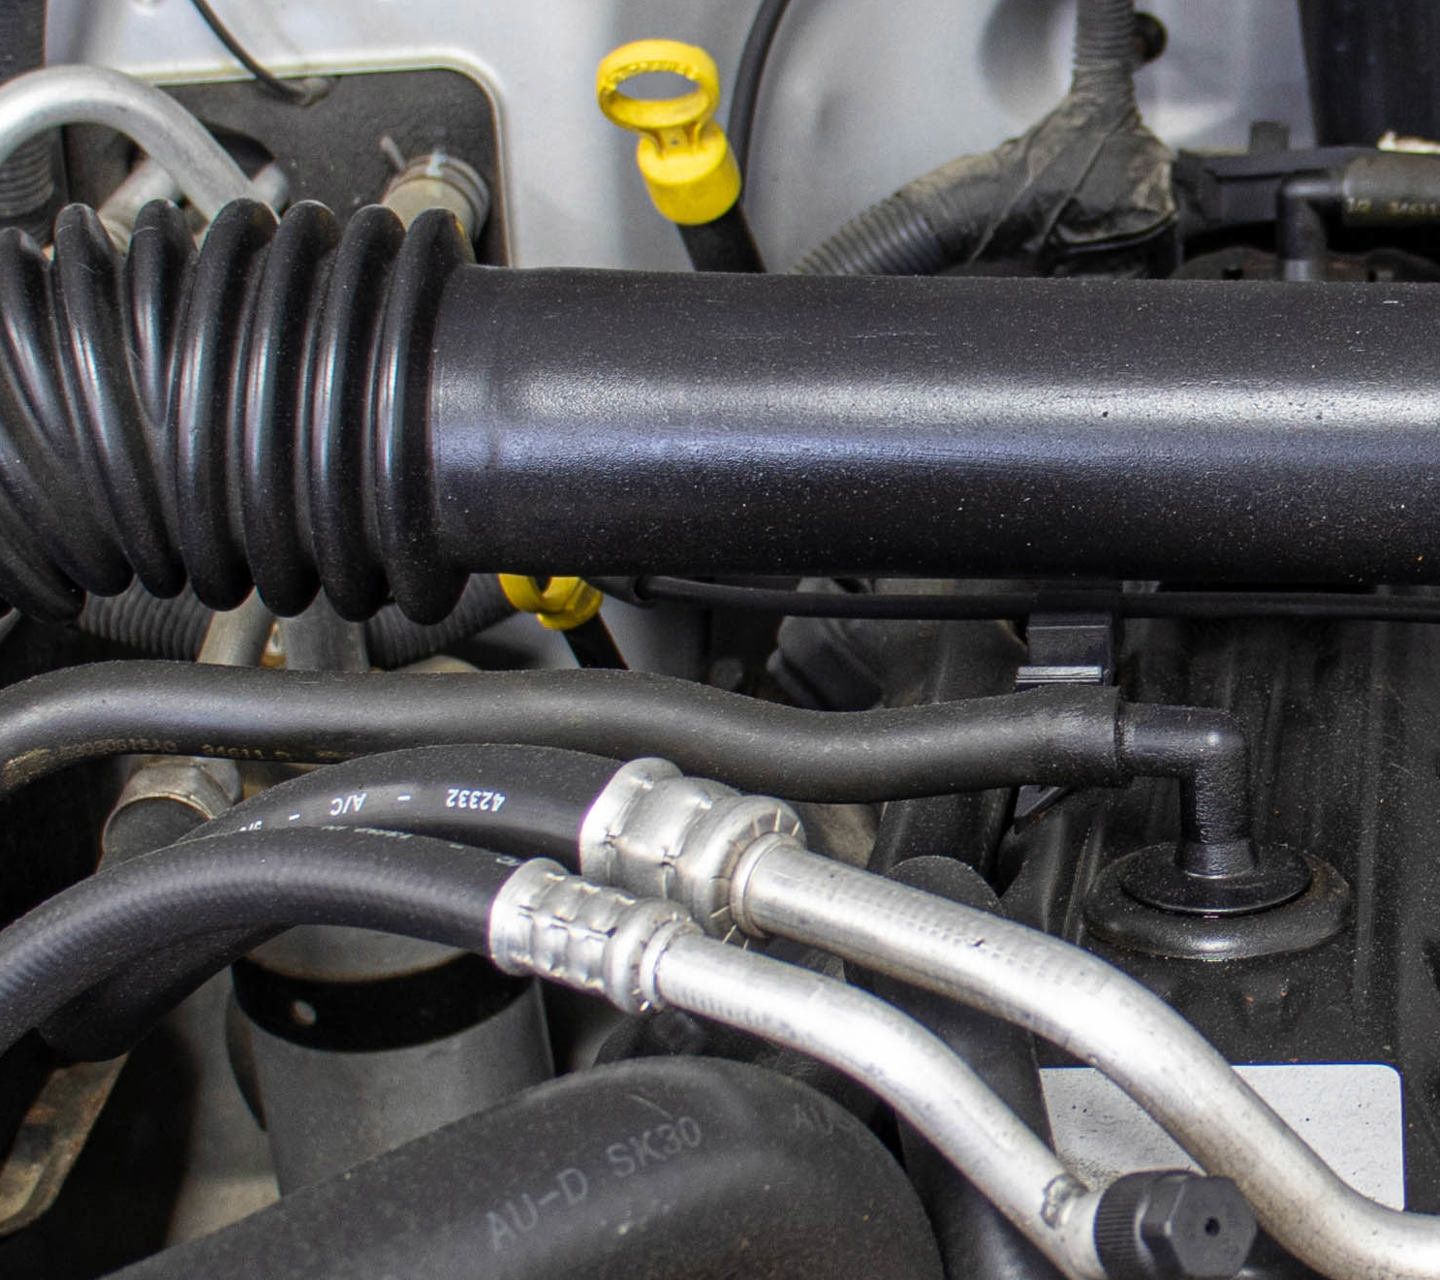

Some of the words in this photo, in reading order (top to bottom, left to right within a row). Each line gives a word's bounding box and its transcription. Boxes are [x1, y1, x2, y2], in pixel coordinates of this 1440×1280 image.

[329, 792, 368, 817] A/C
[445, 788, 507, 813] 42332
[603, 1116, 704, 1180] SK30
